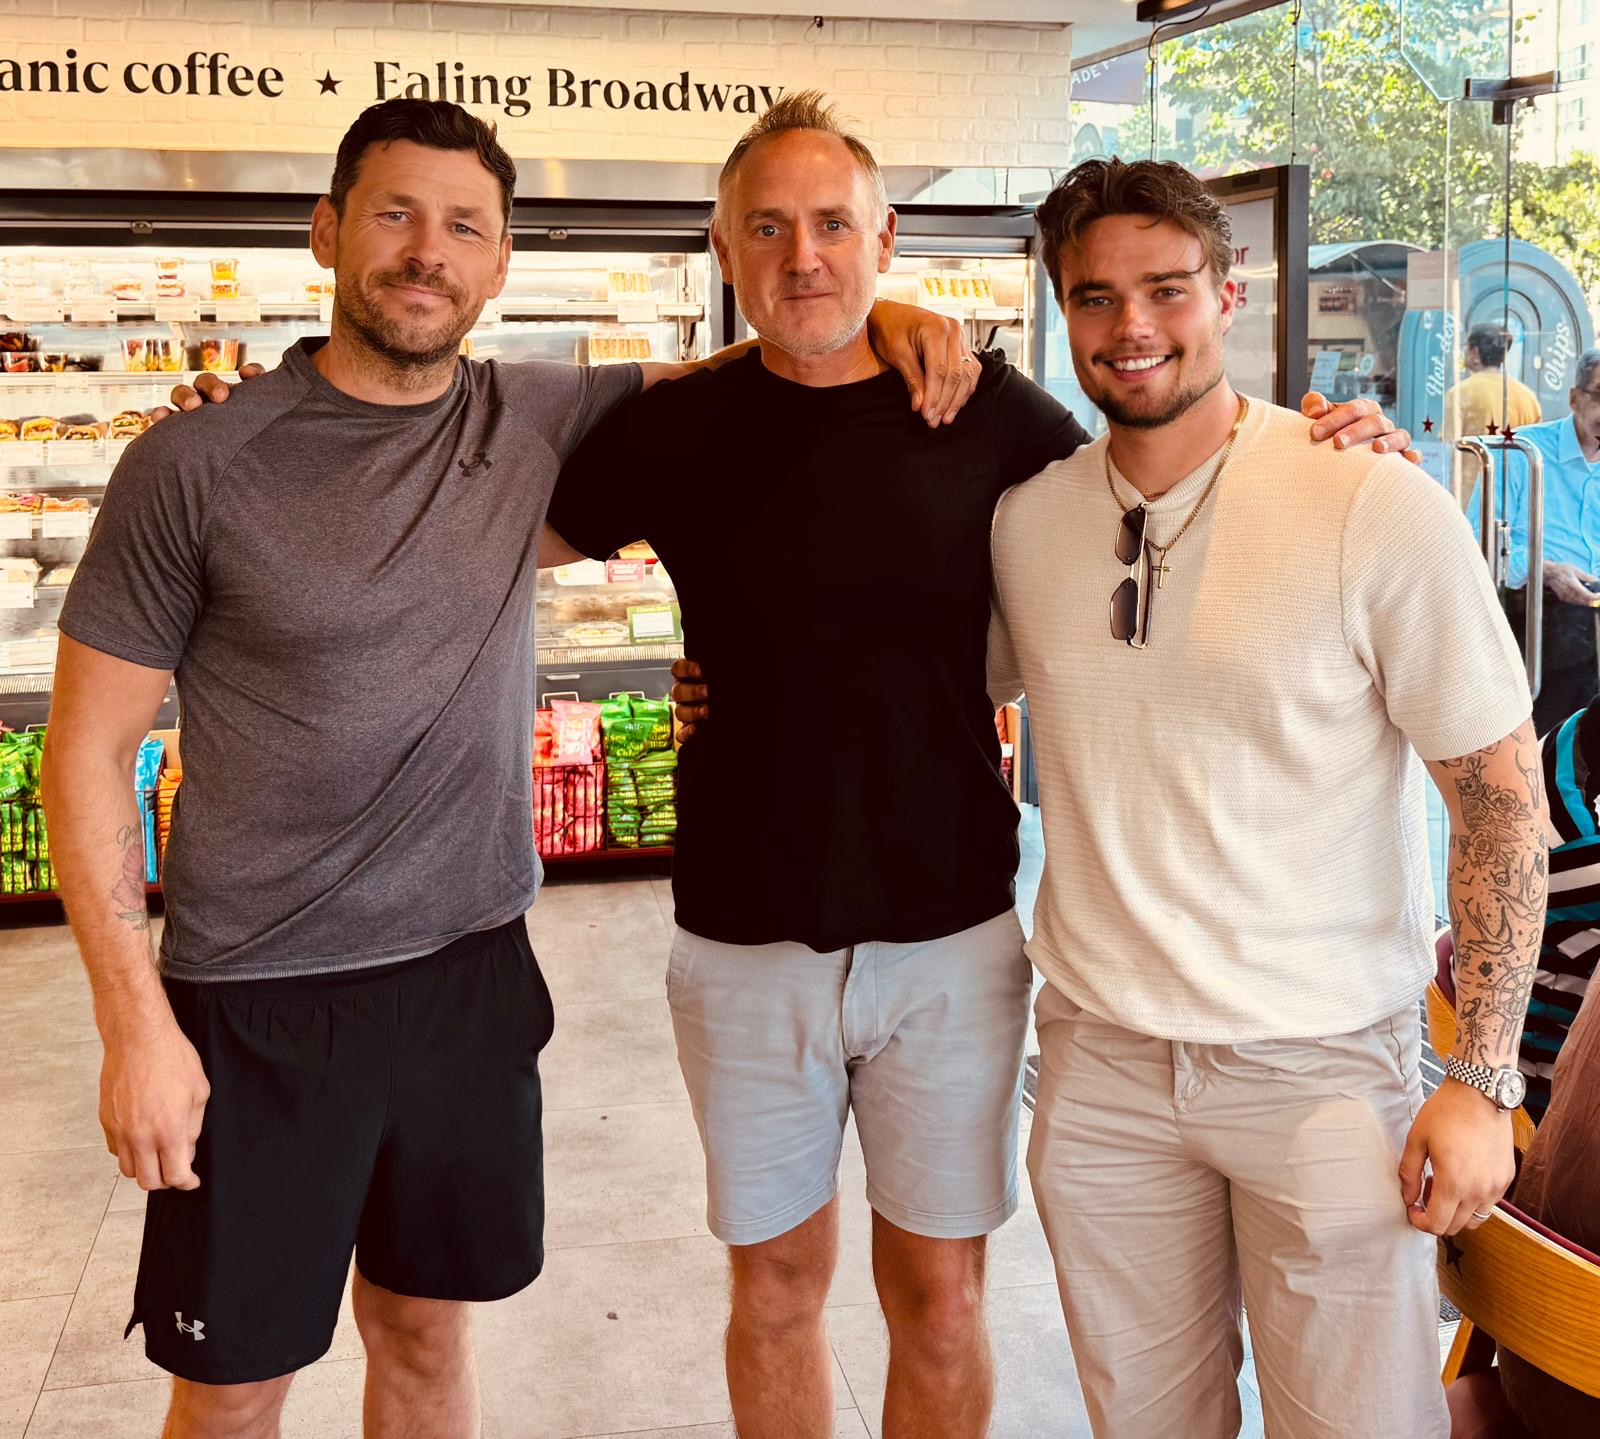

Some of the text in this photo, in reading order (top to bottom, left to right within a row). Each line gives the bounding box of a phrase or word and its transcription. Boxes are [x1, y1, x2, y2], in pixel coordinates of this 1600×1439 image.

[0, 49, 284, 98] anic coffee
[374, 61, 532, 117] Ealing
[1544, 316, 1576, 391] Chips
